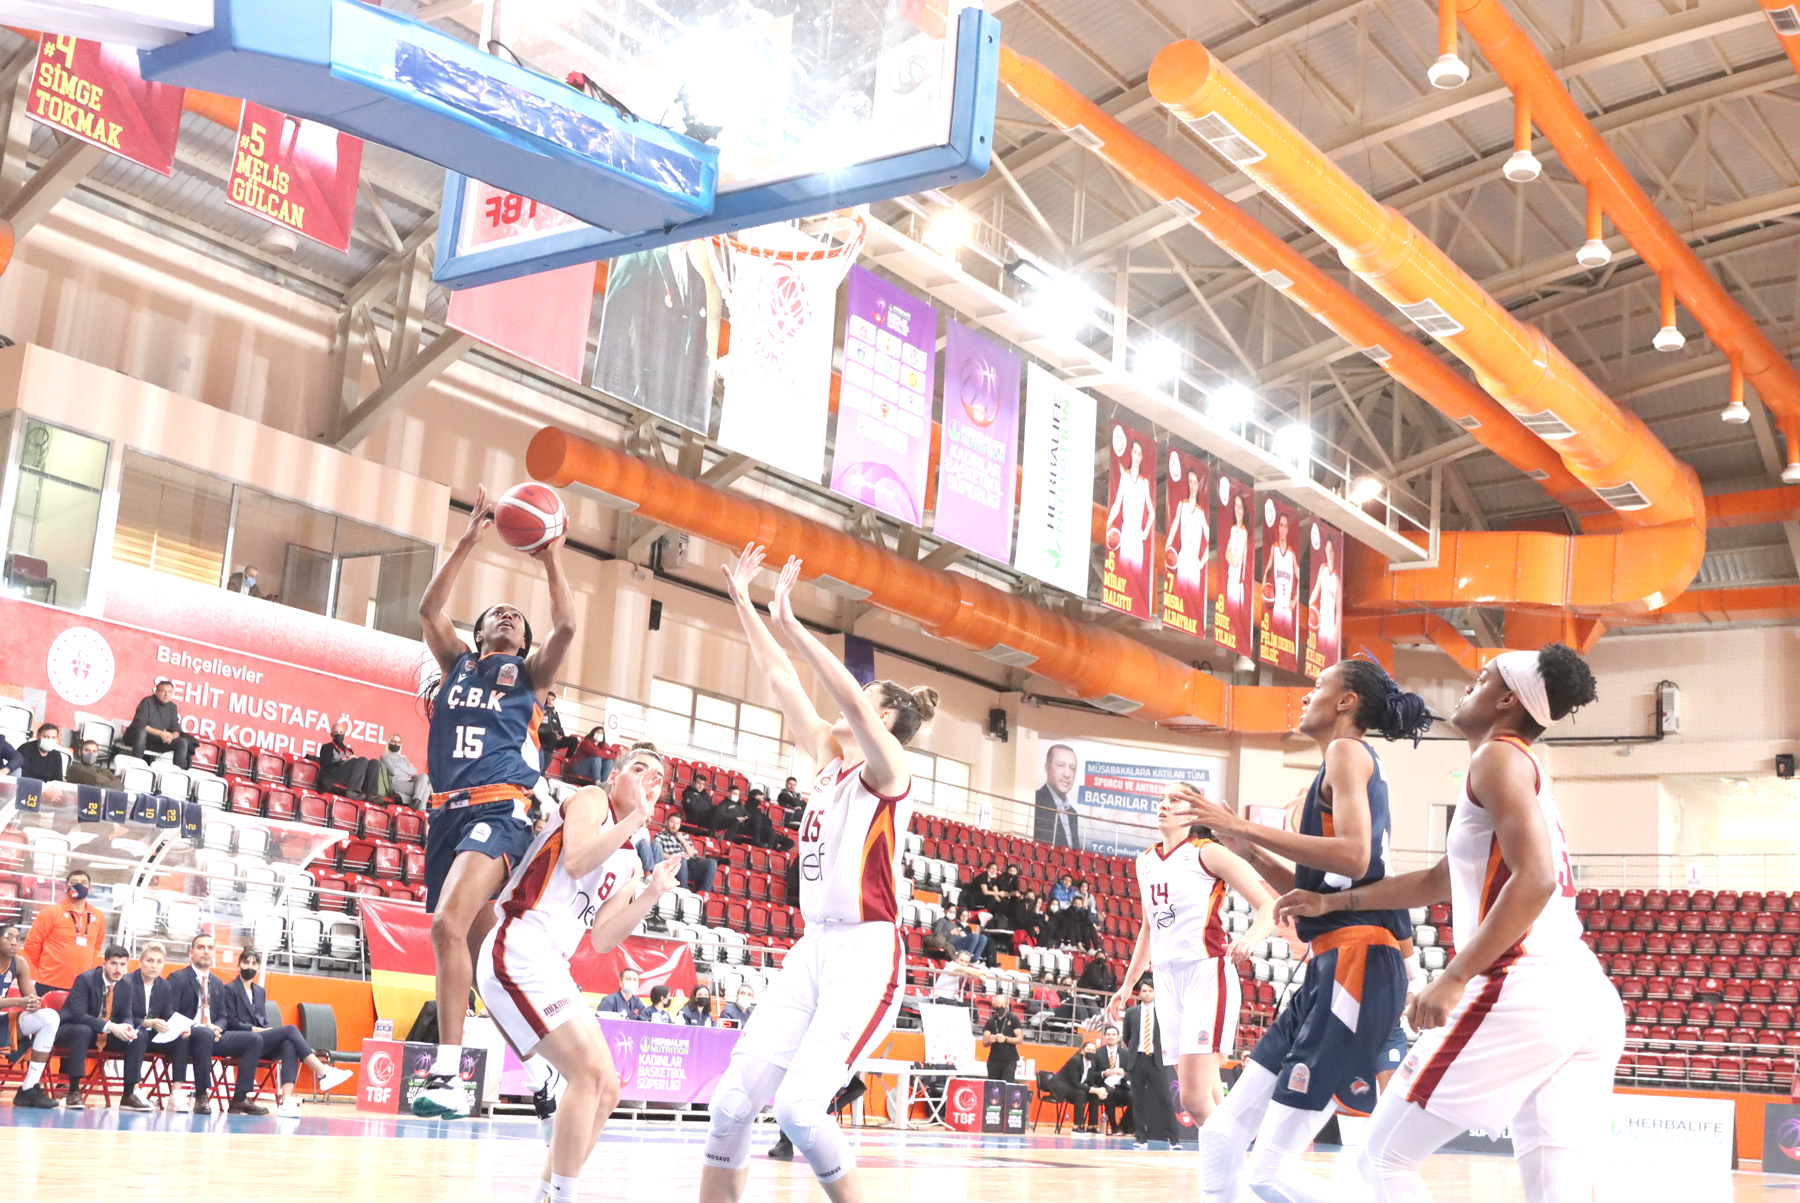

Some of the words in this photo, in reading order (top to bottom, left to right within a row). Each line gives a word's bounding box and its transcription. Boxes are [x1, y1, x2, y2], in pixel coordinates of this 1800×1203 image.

[38, 62, 103, 112] SİMGE
[36, 89, 123, 149] TOKMAK
[240, 122, 266, 157] #5
[235, 151, 290, 195] MELİS
[232, 177, 305, 229] GÜLCAN
[156, 645, 264, 684] Bahçelievler
[447, 684, 506, 712] Ç.B.K
[228, 691, 332, 734] MUSTAFA
[608, 713, 618, 730] G
[222, 722, 321, 758] KOMPLE
[452, 725, 486, 759] 15
[1087, 763, 1151, 777] MÜSABAKALARA
[1152, 769, 1185, 779] KATILAN
[1187, 770, 1205, 780] TÜM
[1094, 776, 1123, 789] SPORCU
[1125, 781, 1134, 790] VE
[1135, 782, 1165, 793] ANTREN
[1084, 790, 1148, 810] BAŞARILAR
[802, 809, 824, 842] 15
[1107, 846, 1140, 857] Cumhurb
[598, 872, 616, 901] 8
[1150, 882, 1169, 906] 14
[638, 1053, 682, 1068] KADINLAR
[650, 1046, 689, 1055] NUTRITION
[637, 1065, 688, 1079] BASKETBOL
[365, 1086, 392, 1103] TBF
[952, 1112, 976, 1125] TBF
[1628, 1117, 1724, 1133] HERBALIFE
